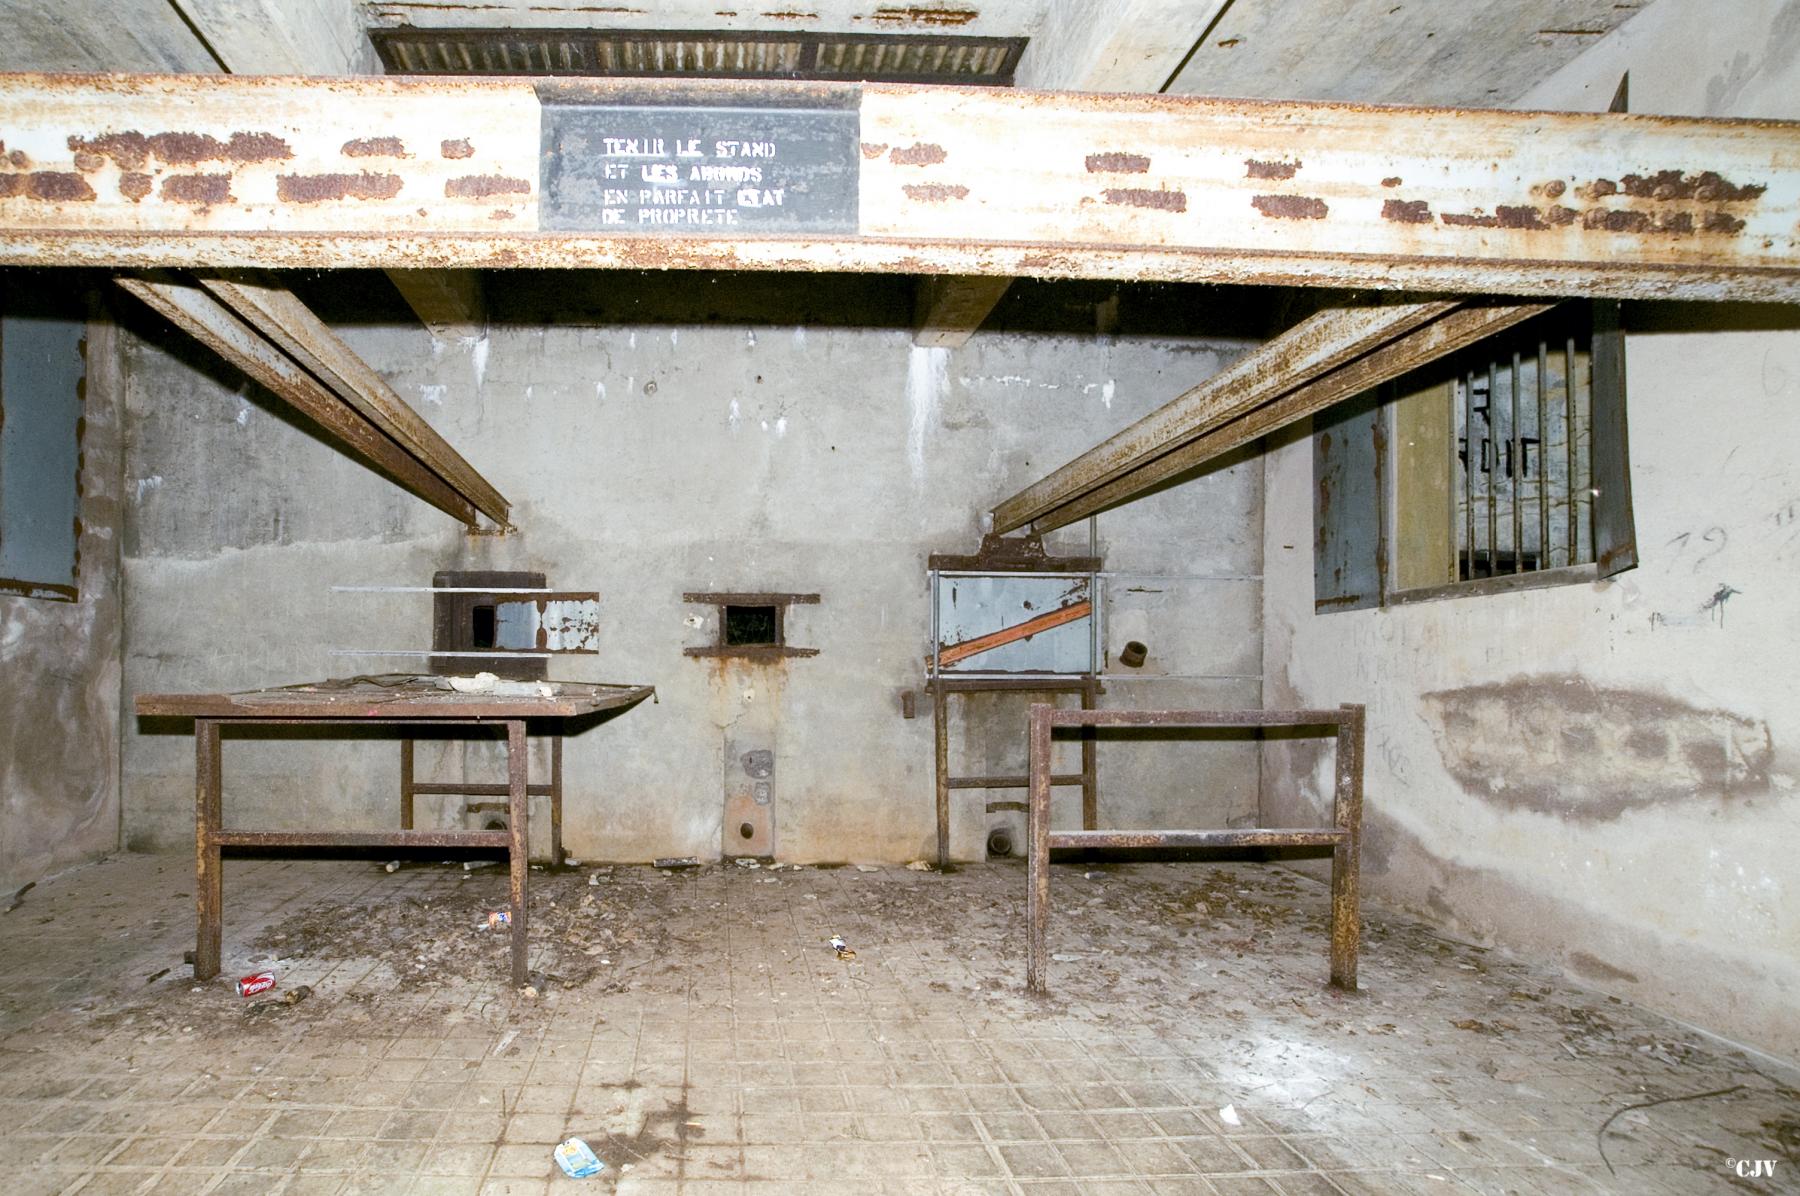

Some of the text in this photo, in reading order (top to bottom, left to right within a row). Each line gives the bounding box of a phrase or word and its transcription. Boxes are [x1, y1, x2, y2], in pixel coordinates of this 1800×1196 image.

[602, 138, 776, 158] TENIR LE STAND
[604, 164, 763, 183] ET LES ABORDS
[603, 189, 629, 206] EN
[639, 189, 726, 206] PARFAIT
[602, 208, 738, 225] DE PROPRETE
